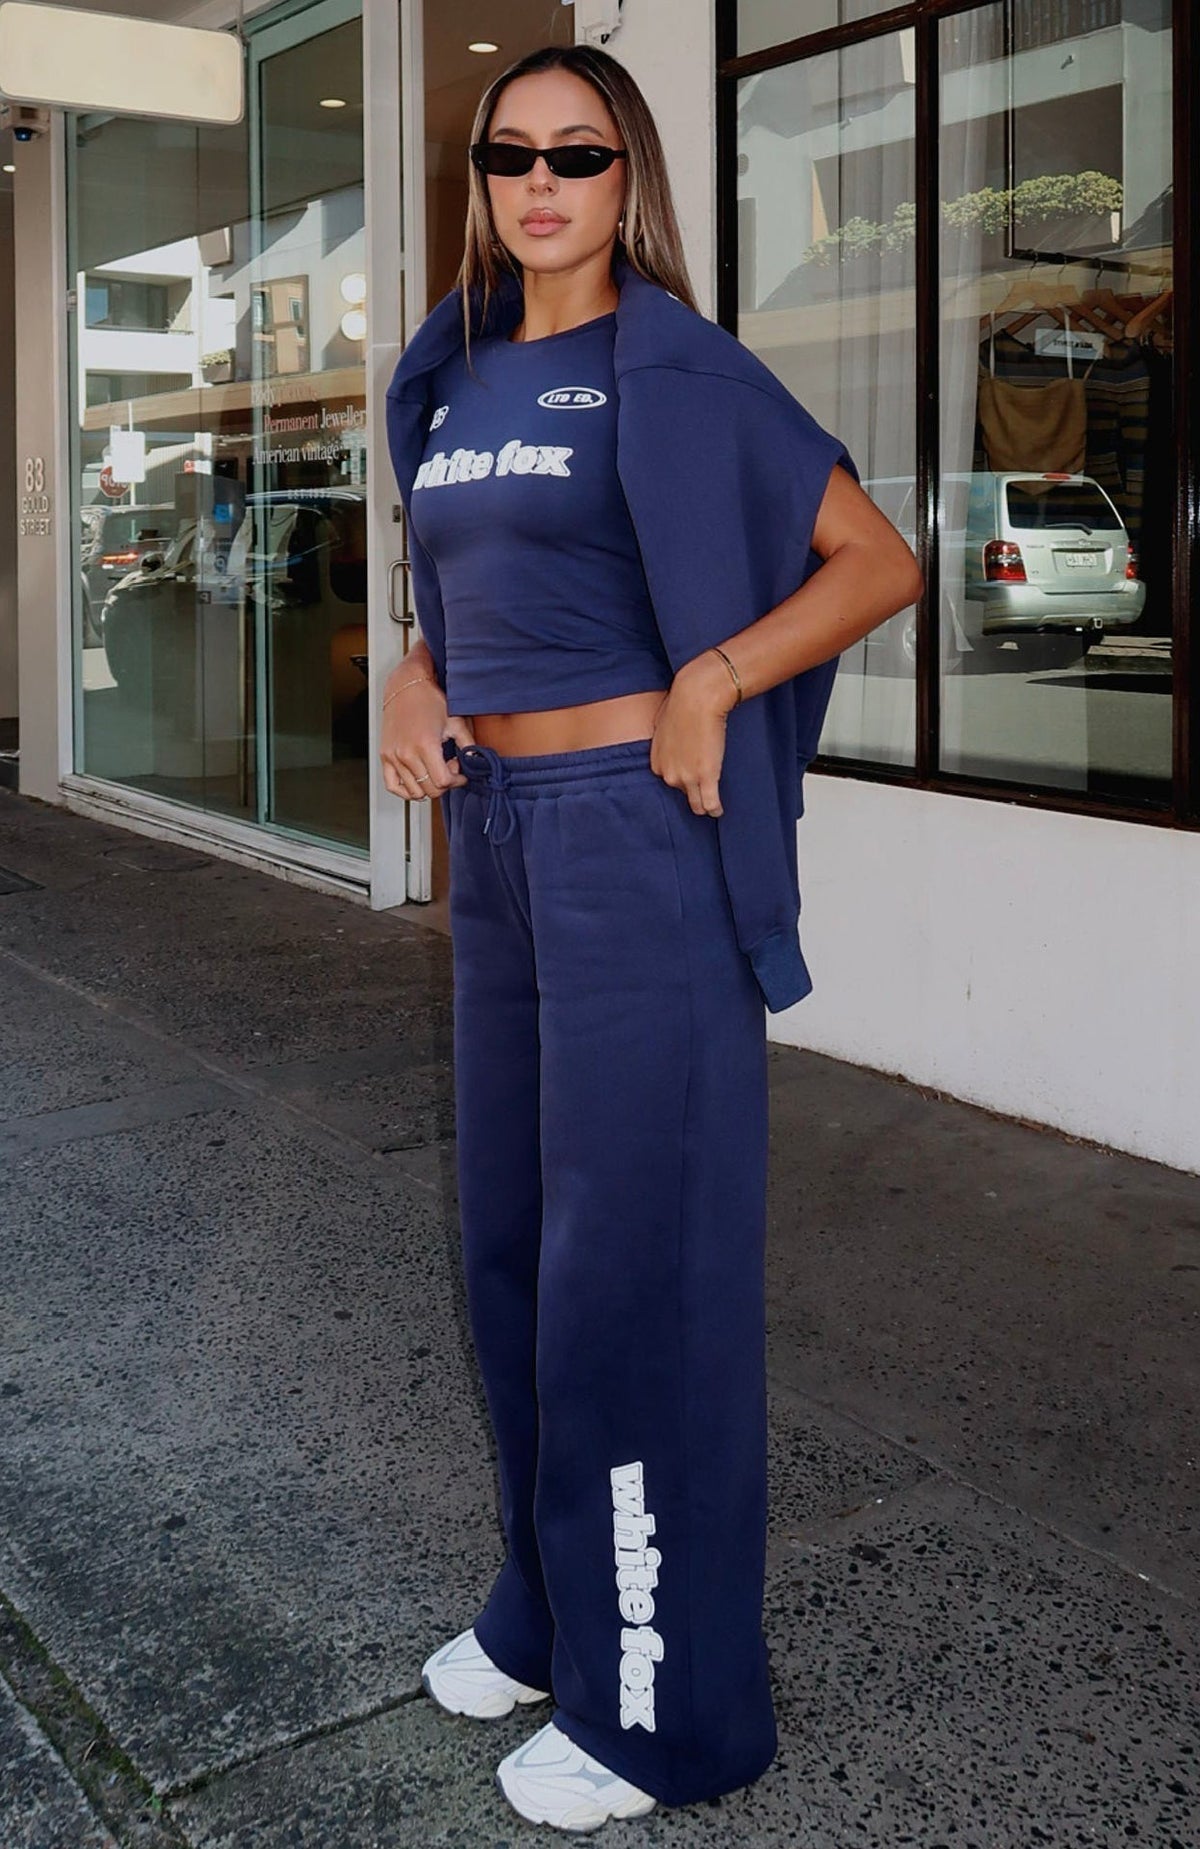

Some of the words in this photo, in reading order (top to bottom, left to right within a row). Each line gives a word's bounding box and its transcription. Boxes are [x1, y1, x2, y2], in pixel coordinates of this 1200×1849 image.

[547, 393, 571, 404] LTD
[263, 412, 319, 434] Permanent
[252, 444, 300, 465] American
[301, 441, 340, 466] vintage
[495, 439, 574, 478] fox
[25, 457, 45, 493] 83
[20, 518, 51, 536] STREET
[610, 1460, 663, 1625] white
[619, 1625, 665, 1733] fox
